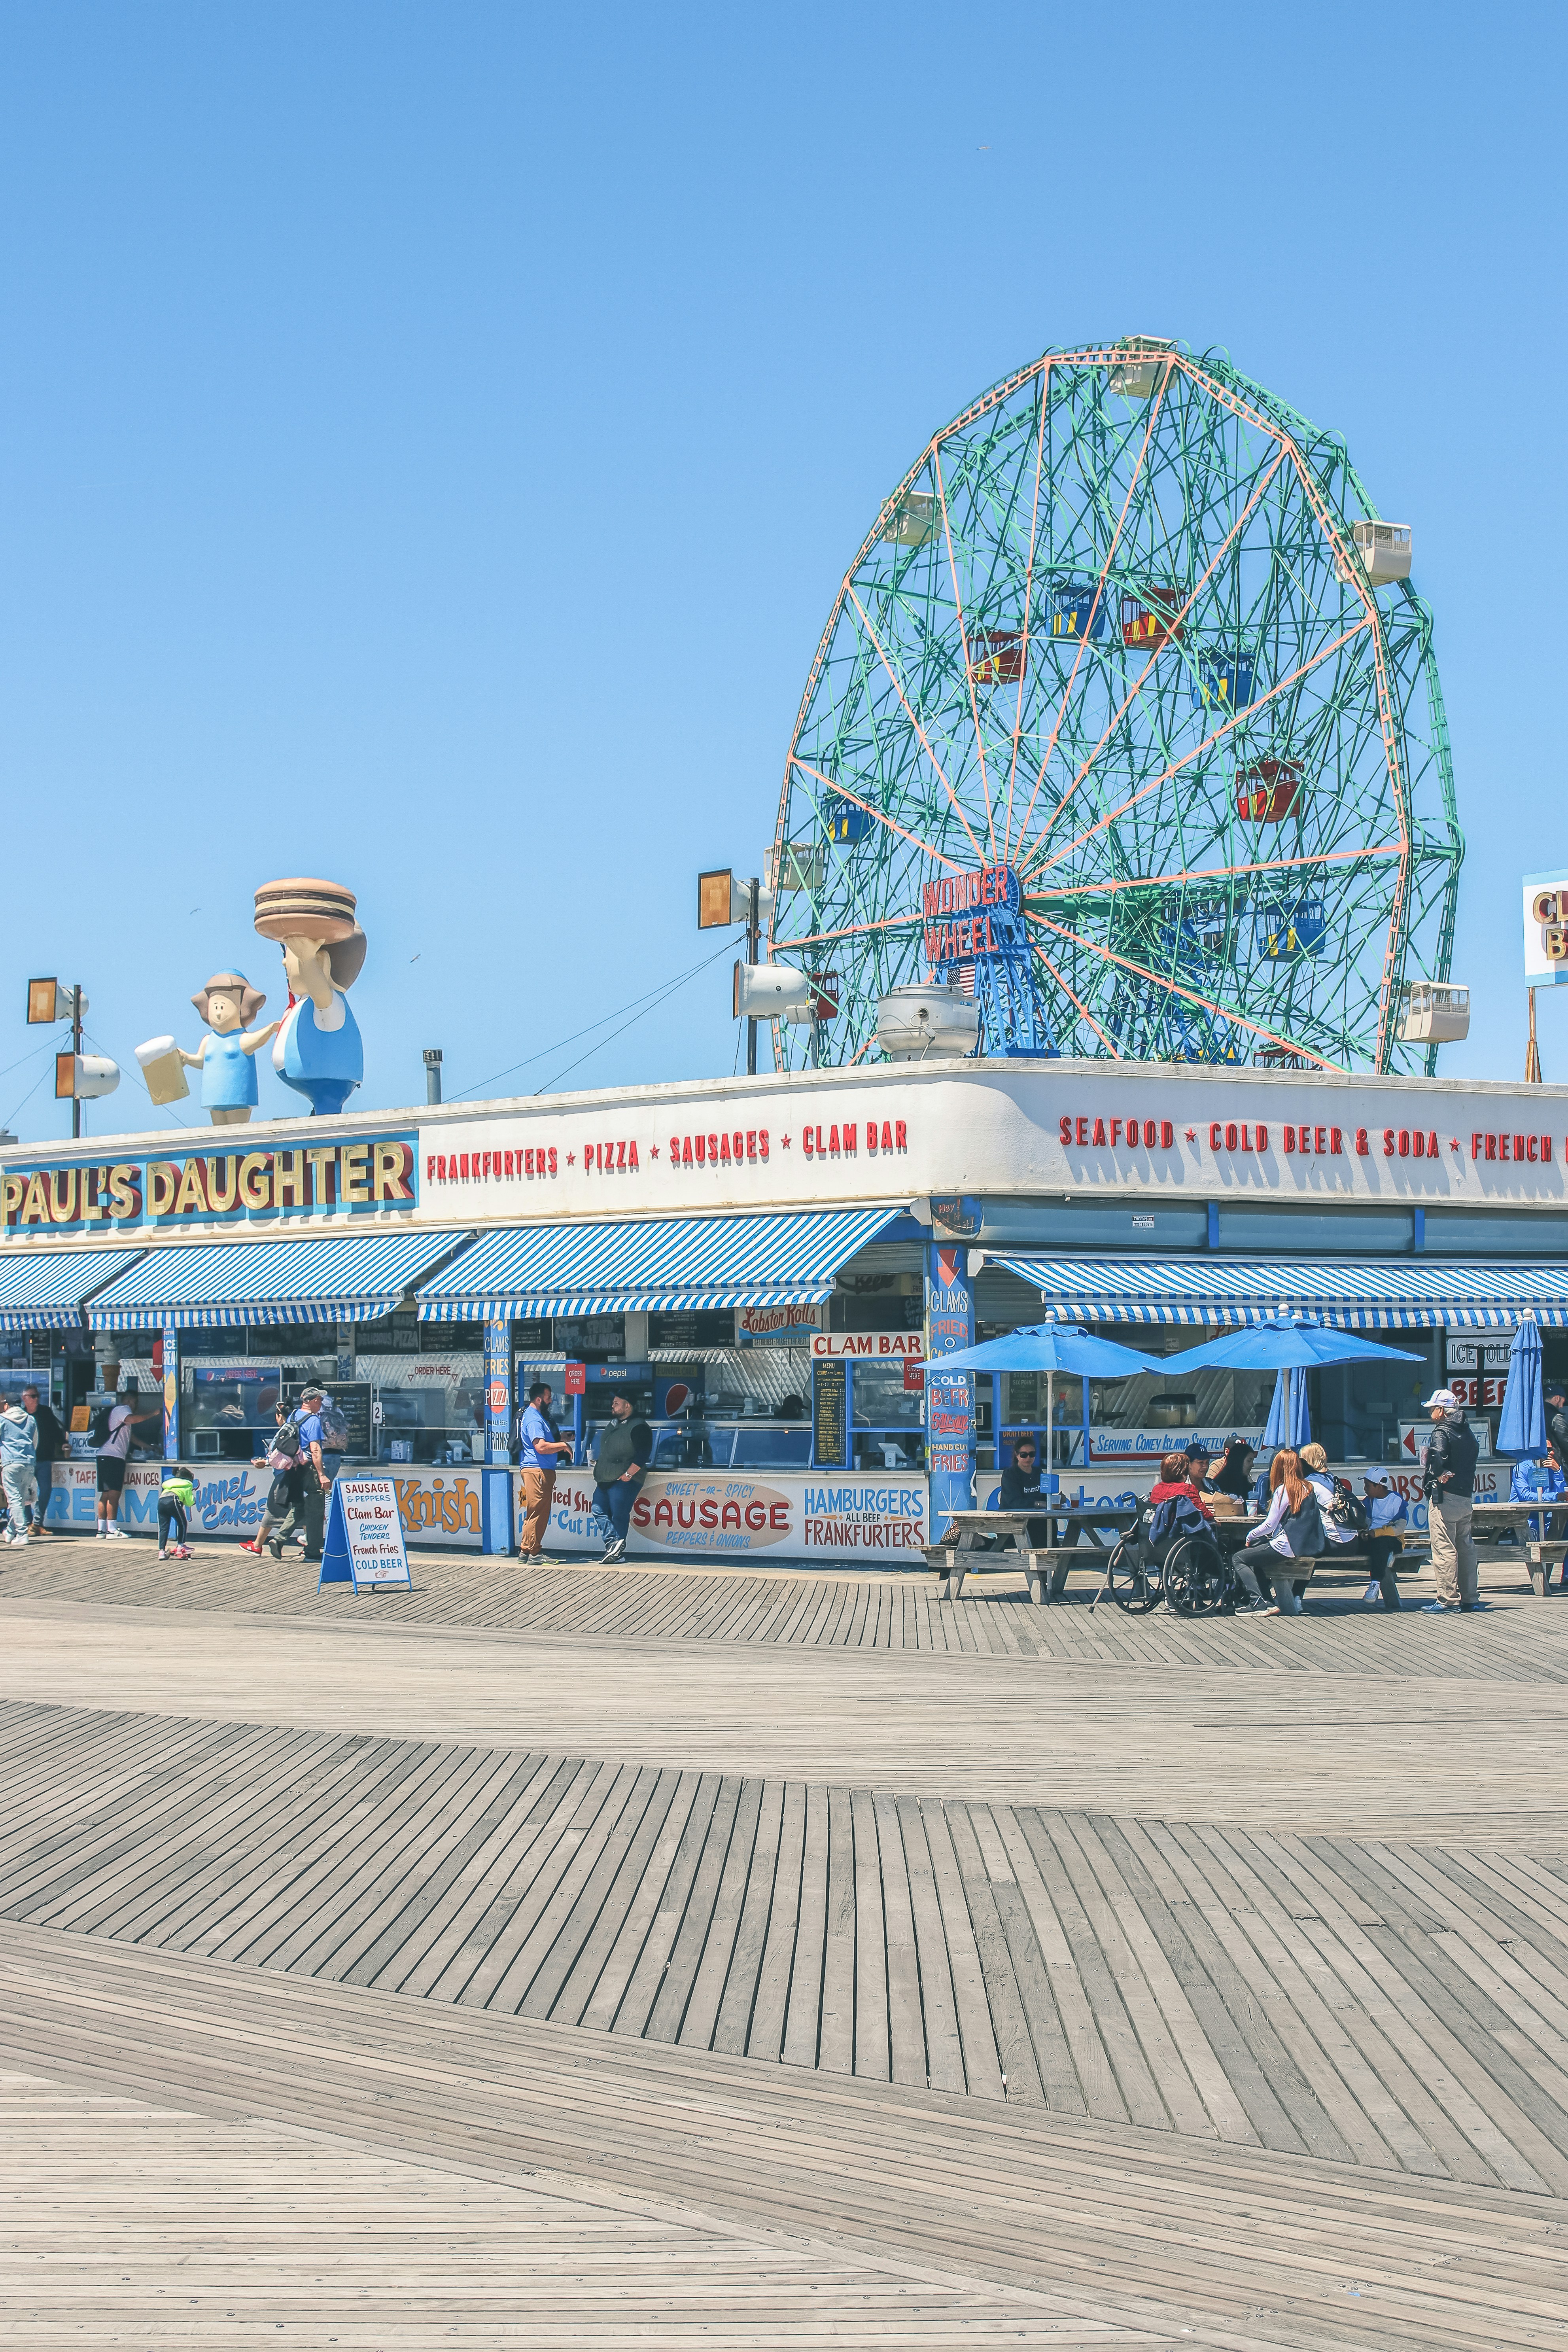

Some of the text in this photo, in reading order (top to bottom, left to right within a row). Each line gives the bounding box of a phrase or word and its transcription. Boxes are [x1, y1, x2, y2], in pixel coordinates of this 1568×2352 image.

[923, 865, 1007, 918] WONDER
[924, 916, 999, 961] WHEEL
[1059, 1116, 1173, 1149] SEAFOOD
[1209, 1122, 1268, 1152] COLD
[1284, 1125, 1342, 1154] BEER
[1356, 1128, 1369, 1156] &
[1383, 1129, 1439, 1159] SODA
[1472, 1132, 1552, 1162] FRENCH
[427, 1120, 907, 1180] FRANKFURTERS PIZZA SAUSAGES CLAM BAR
[1, 1142, 414, 1226] PAUL'S DAUGHTER
[931, 1290, 968, 1313] CLAMS
[741, 1304, 818, 1336] Lobster Rolls
[931, 1319, 968, 1341] FRIED
[163, 1340, 177, 1350] ICE
[485, 1336, 510, 1353] CLAMS
[813, 1336, 872, 1355] CLAM
[878, 1335, 921, 1355] BAR
[1451, 1343, 1512, 1363] ICE OLD
[225, 1370, 242, 1378] ORDER
[243, 1369, 258, 1378] HERE
[414, 1366, 451, 1375] ORDER HERE
[485, 1358, 510, 1376] FRIES
[608, 1369, 627, 1378] pepsi
[931, 1376, 967, 1386] COLD
[485, 1388, 510, 1406] PIZZA
[931, 1388, 968, 1408] BEER
[375, 1407, 380, 1419] 2
[1097, 1434, 1135, 1452] SERVING
[1135, 1433, 1161, 1451] CONEY
[1162, 1434, 1189, 1451] ISLAND
[932, 1453, 969, 1472] FRIES
[76, 1470, 96, 1484] TAFF
[144, 1472, 159, 1485] ICES
[345, 1483, 390, 1494] SAUSAGE
[665, 1482, 700, 1496] SWEET
[725, 1484, 755, 1499] SPICY
[1024, 1485, 1041, 1493] brunch
[394, 1478, 482, 1535] Knish
[804, 1488, 924, 1518] HAMBURGERS
[202, 1497, 268, 1531] Cakes
[347, 1506, 394, 1520] Clam Bar
[633, 1497, 789, 1531] SAUSAGE
[845, 1513, 881, 1523] ALL BEEF
[359, 1523, 389, 1532] CHICKEN
[359, 1532, 390, 1540] TENDERS
[805, 1519, 925, 1549] FRANKFURTERS
[666, 1531, 708, 1546] PEPPERS
[716, 1533, 751, 1548] ONIONS
[352, 1544, 399, 1555] French Fries
[356, 1559, 403, 1570] COLD BEER
